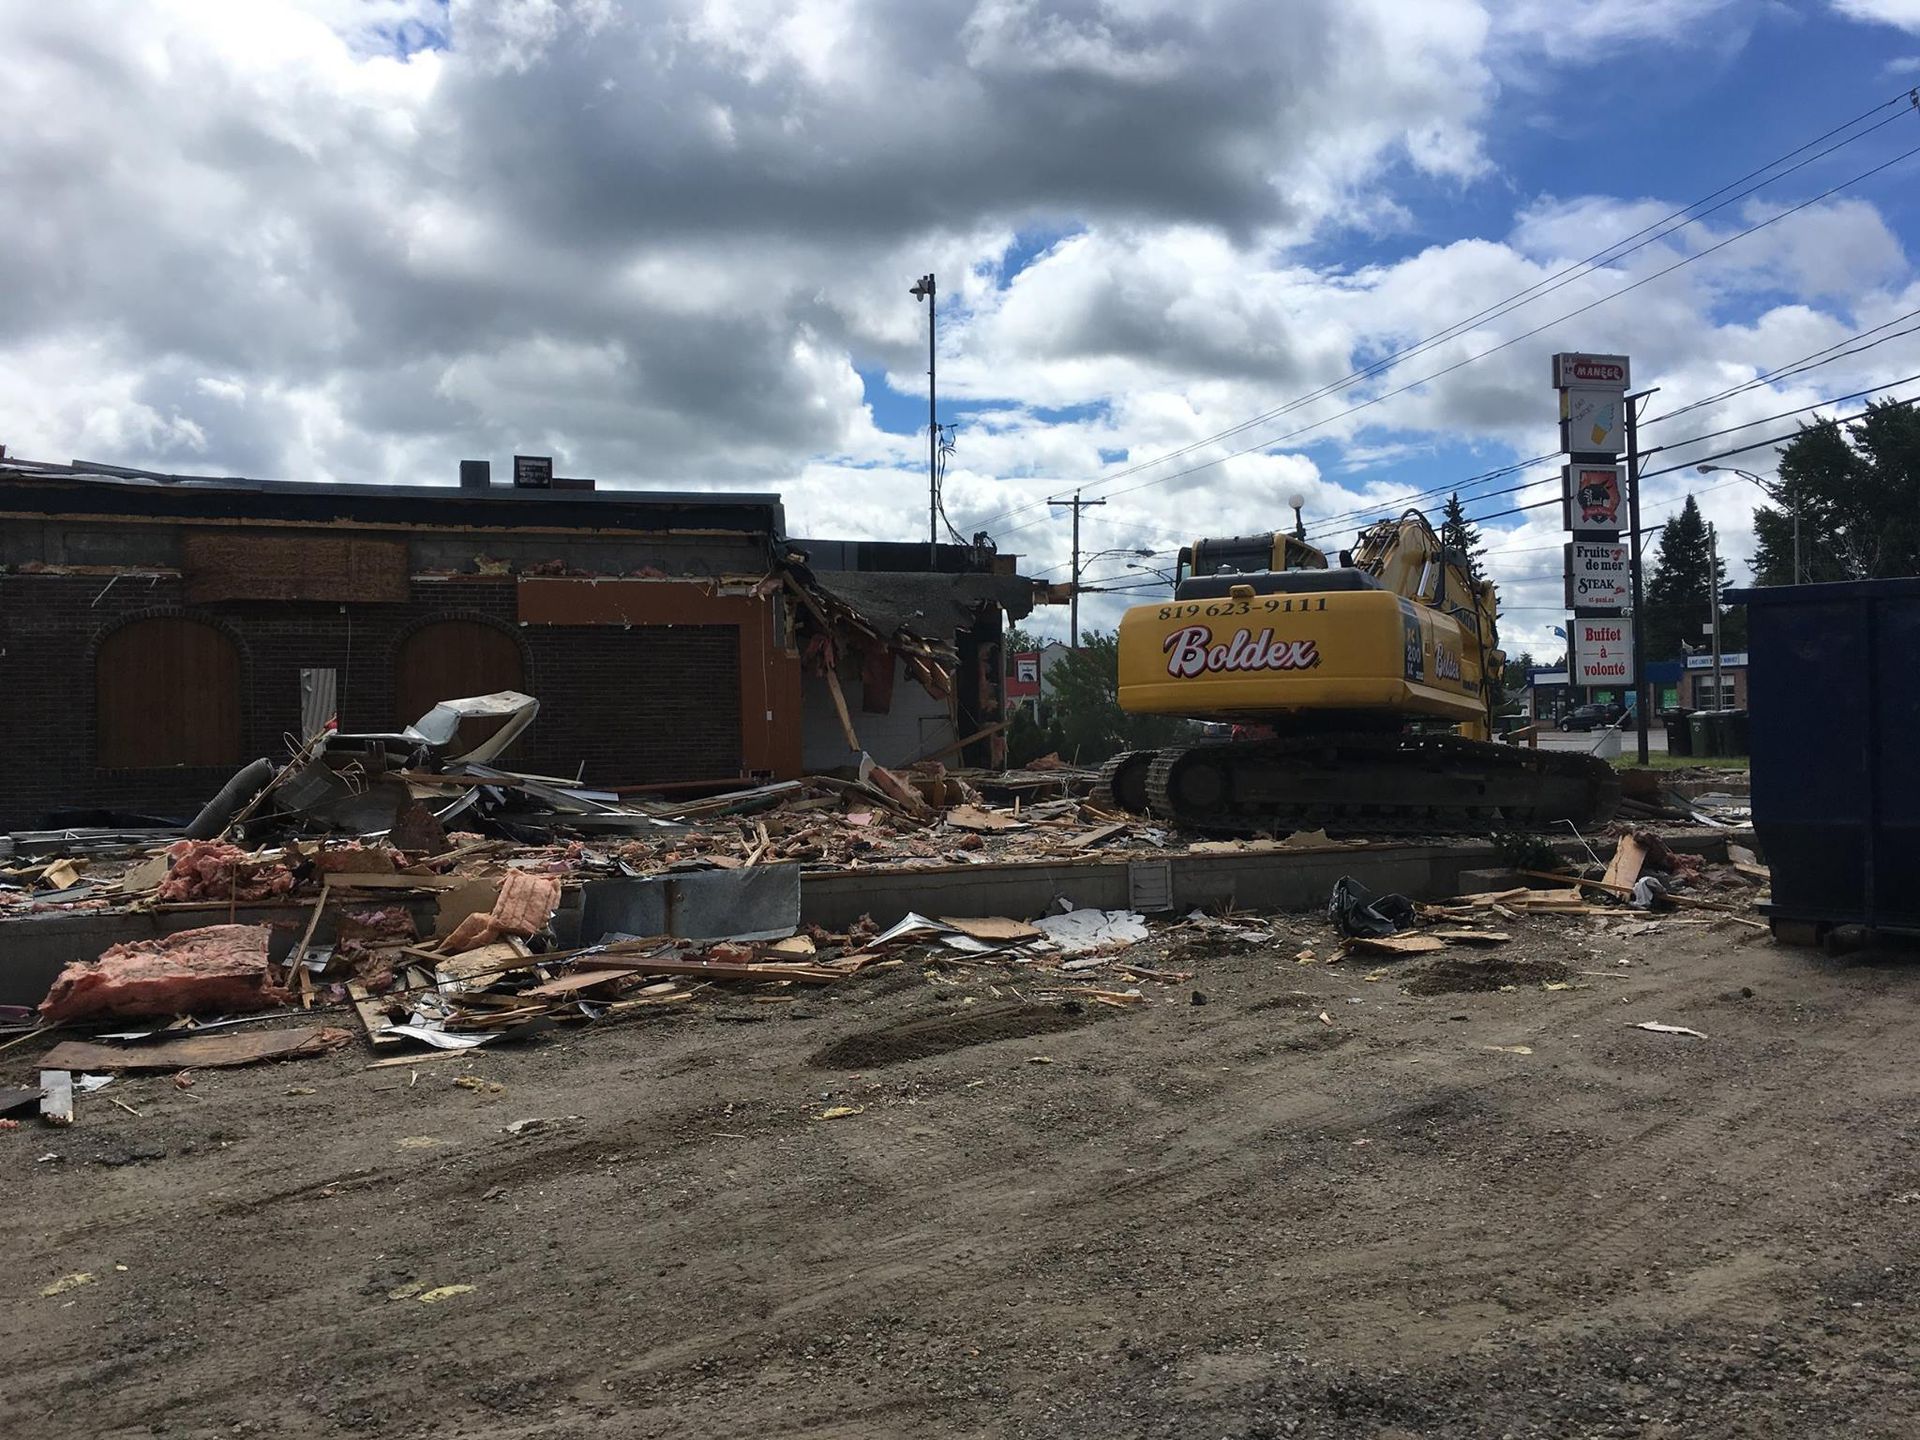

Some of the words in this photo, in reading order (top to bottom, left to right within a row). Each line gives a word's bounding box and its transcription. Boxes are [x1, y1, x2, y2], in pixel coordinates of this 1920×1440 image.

[1577, 546, 1610, 558] Fruits
[1586, 559, 1599, 570] de
[1601, 561, 1624, 571] mer
[1578, 578, 1615, 594] STEAK
[1158, 603, 1200, 621] 819
[1205, 597, 1329, 617] 623-9111
[1585, 627, 1621, 641] Buffet
[1163, 624, 1320, 678] Boldex
[1600, 645, 1607, 658] à
[1584, 661, 1625, 676] volonté
